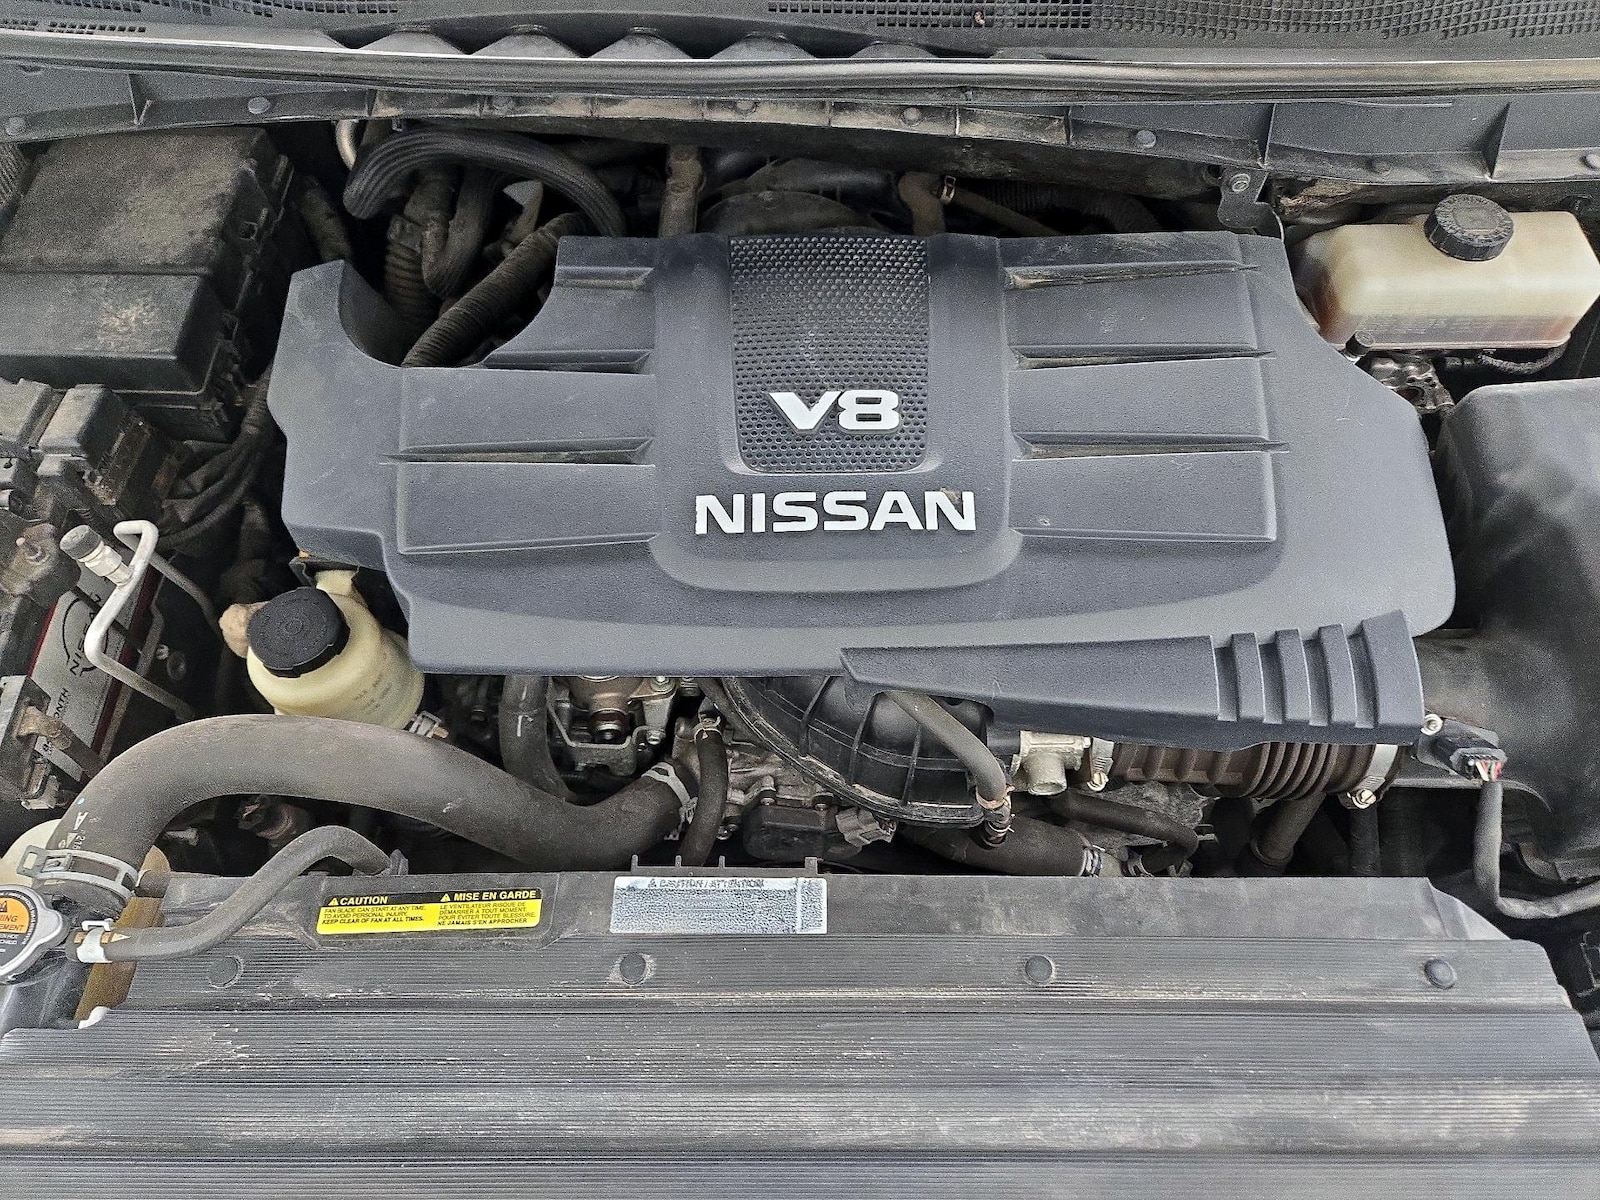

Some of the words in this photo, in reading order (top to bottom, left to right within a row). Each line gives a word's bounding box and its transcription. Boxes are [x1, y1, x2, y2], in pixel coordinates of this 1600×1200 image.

[769, 390, 900, 430] V8
[695, 491, 977, 534] NISSAN
[340, 896, 388, 905] CAUTION
[454, 892, 480, 901] MISE
[482, 891, 497, 900] EN
[499, 890, 537, 899] GARDE
